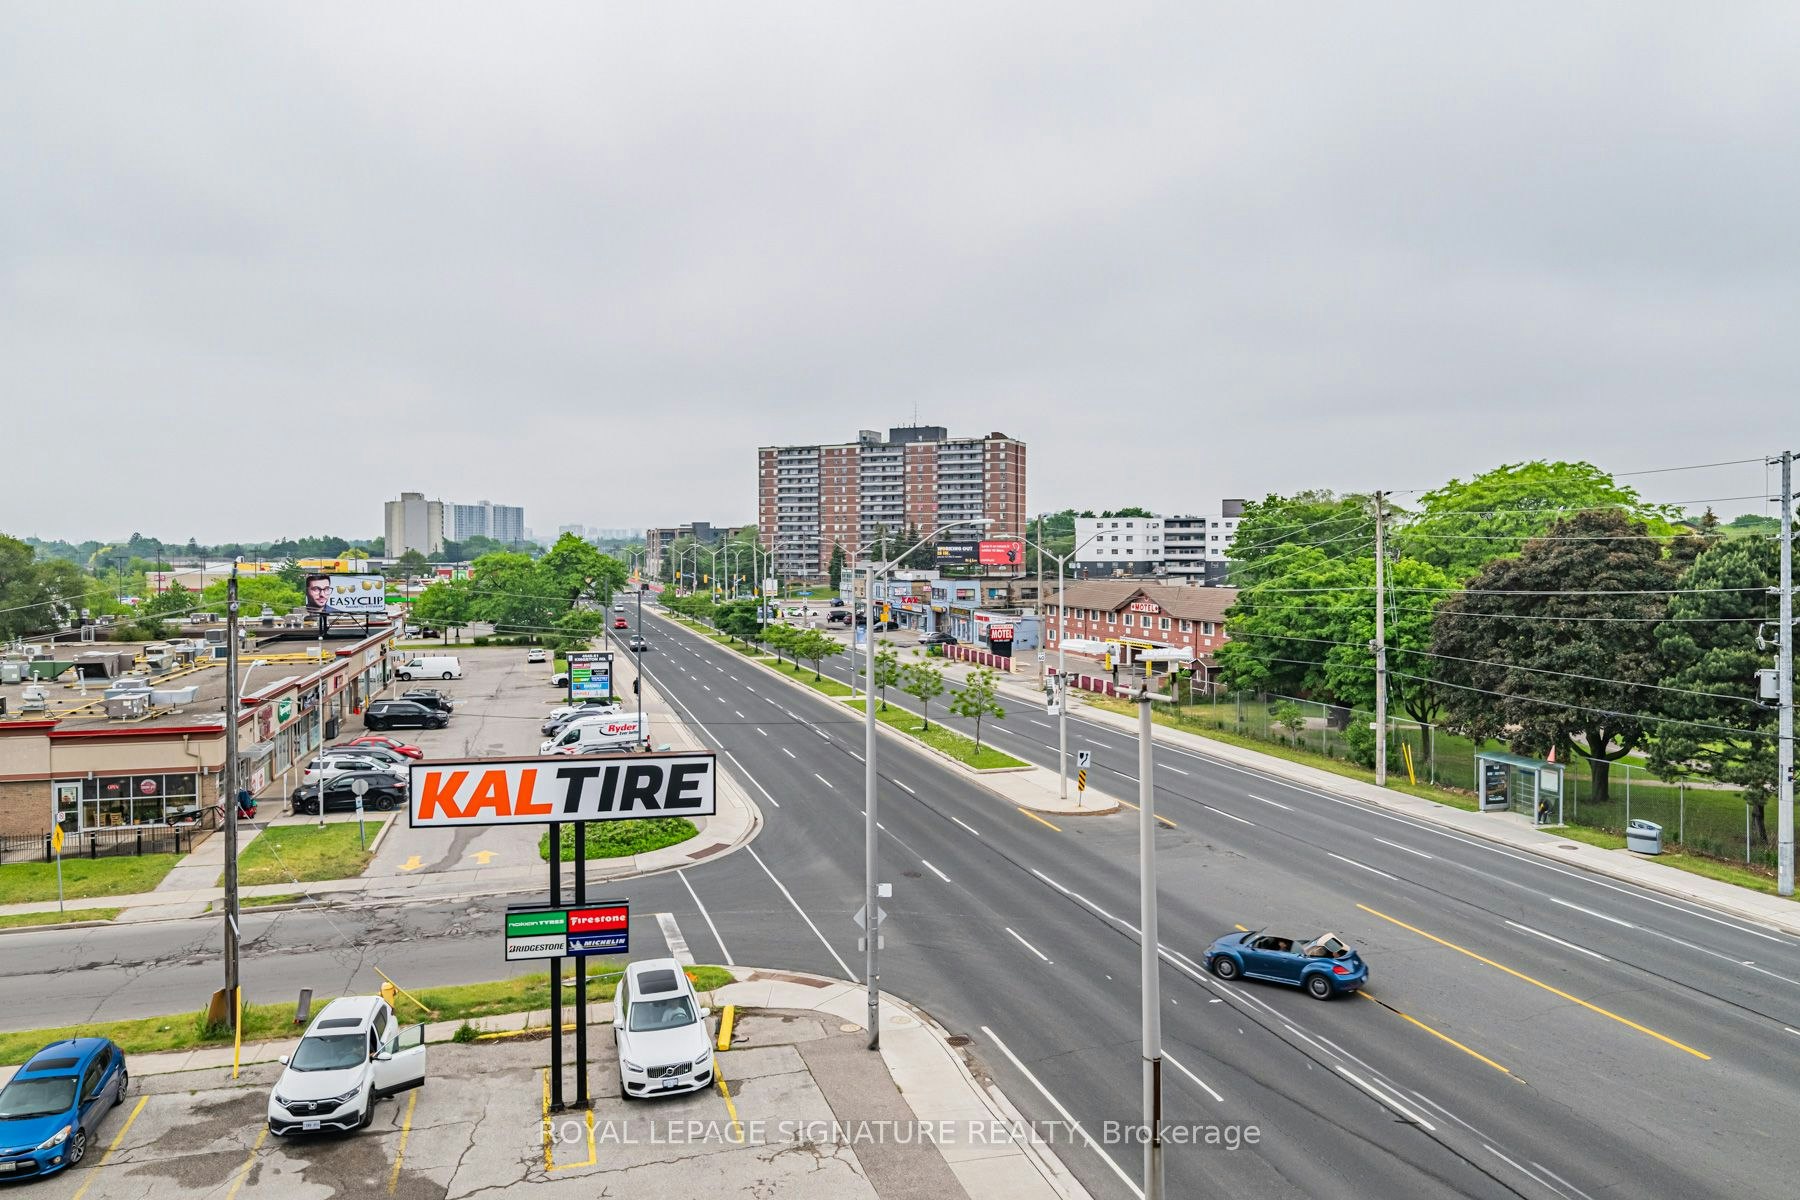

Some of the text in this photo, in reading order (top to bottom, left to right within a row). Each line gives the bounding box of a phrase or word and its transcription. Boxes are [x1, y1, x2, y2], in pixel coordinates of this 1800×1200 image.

[330, 596, 383, 606] EASYCLIP
[1135, 604, 1155, 612] MOTEL
[991, 629, 1013, 639] MOTEL
[608, 723, 637, 733] Ryder
[417, 763, 709, 820] KAL TIRE
[570, 914, 626, 926] Firestone
[508, 942, 565, 953] BRIDGESTONE
[583, 938, 626, 947] MICHELIN
